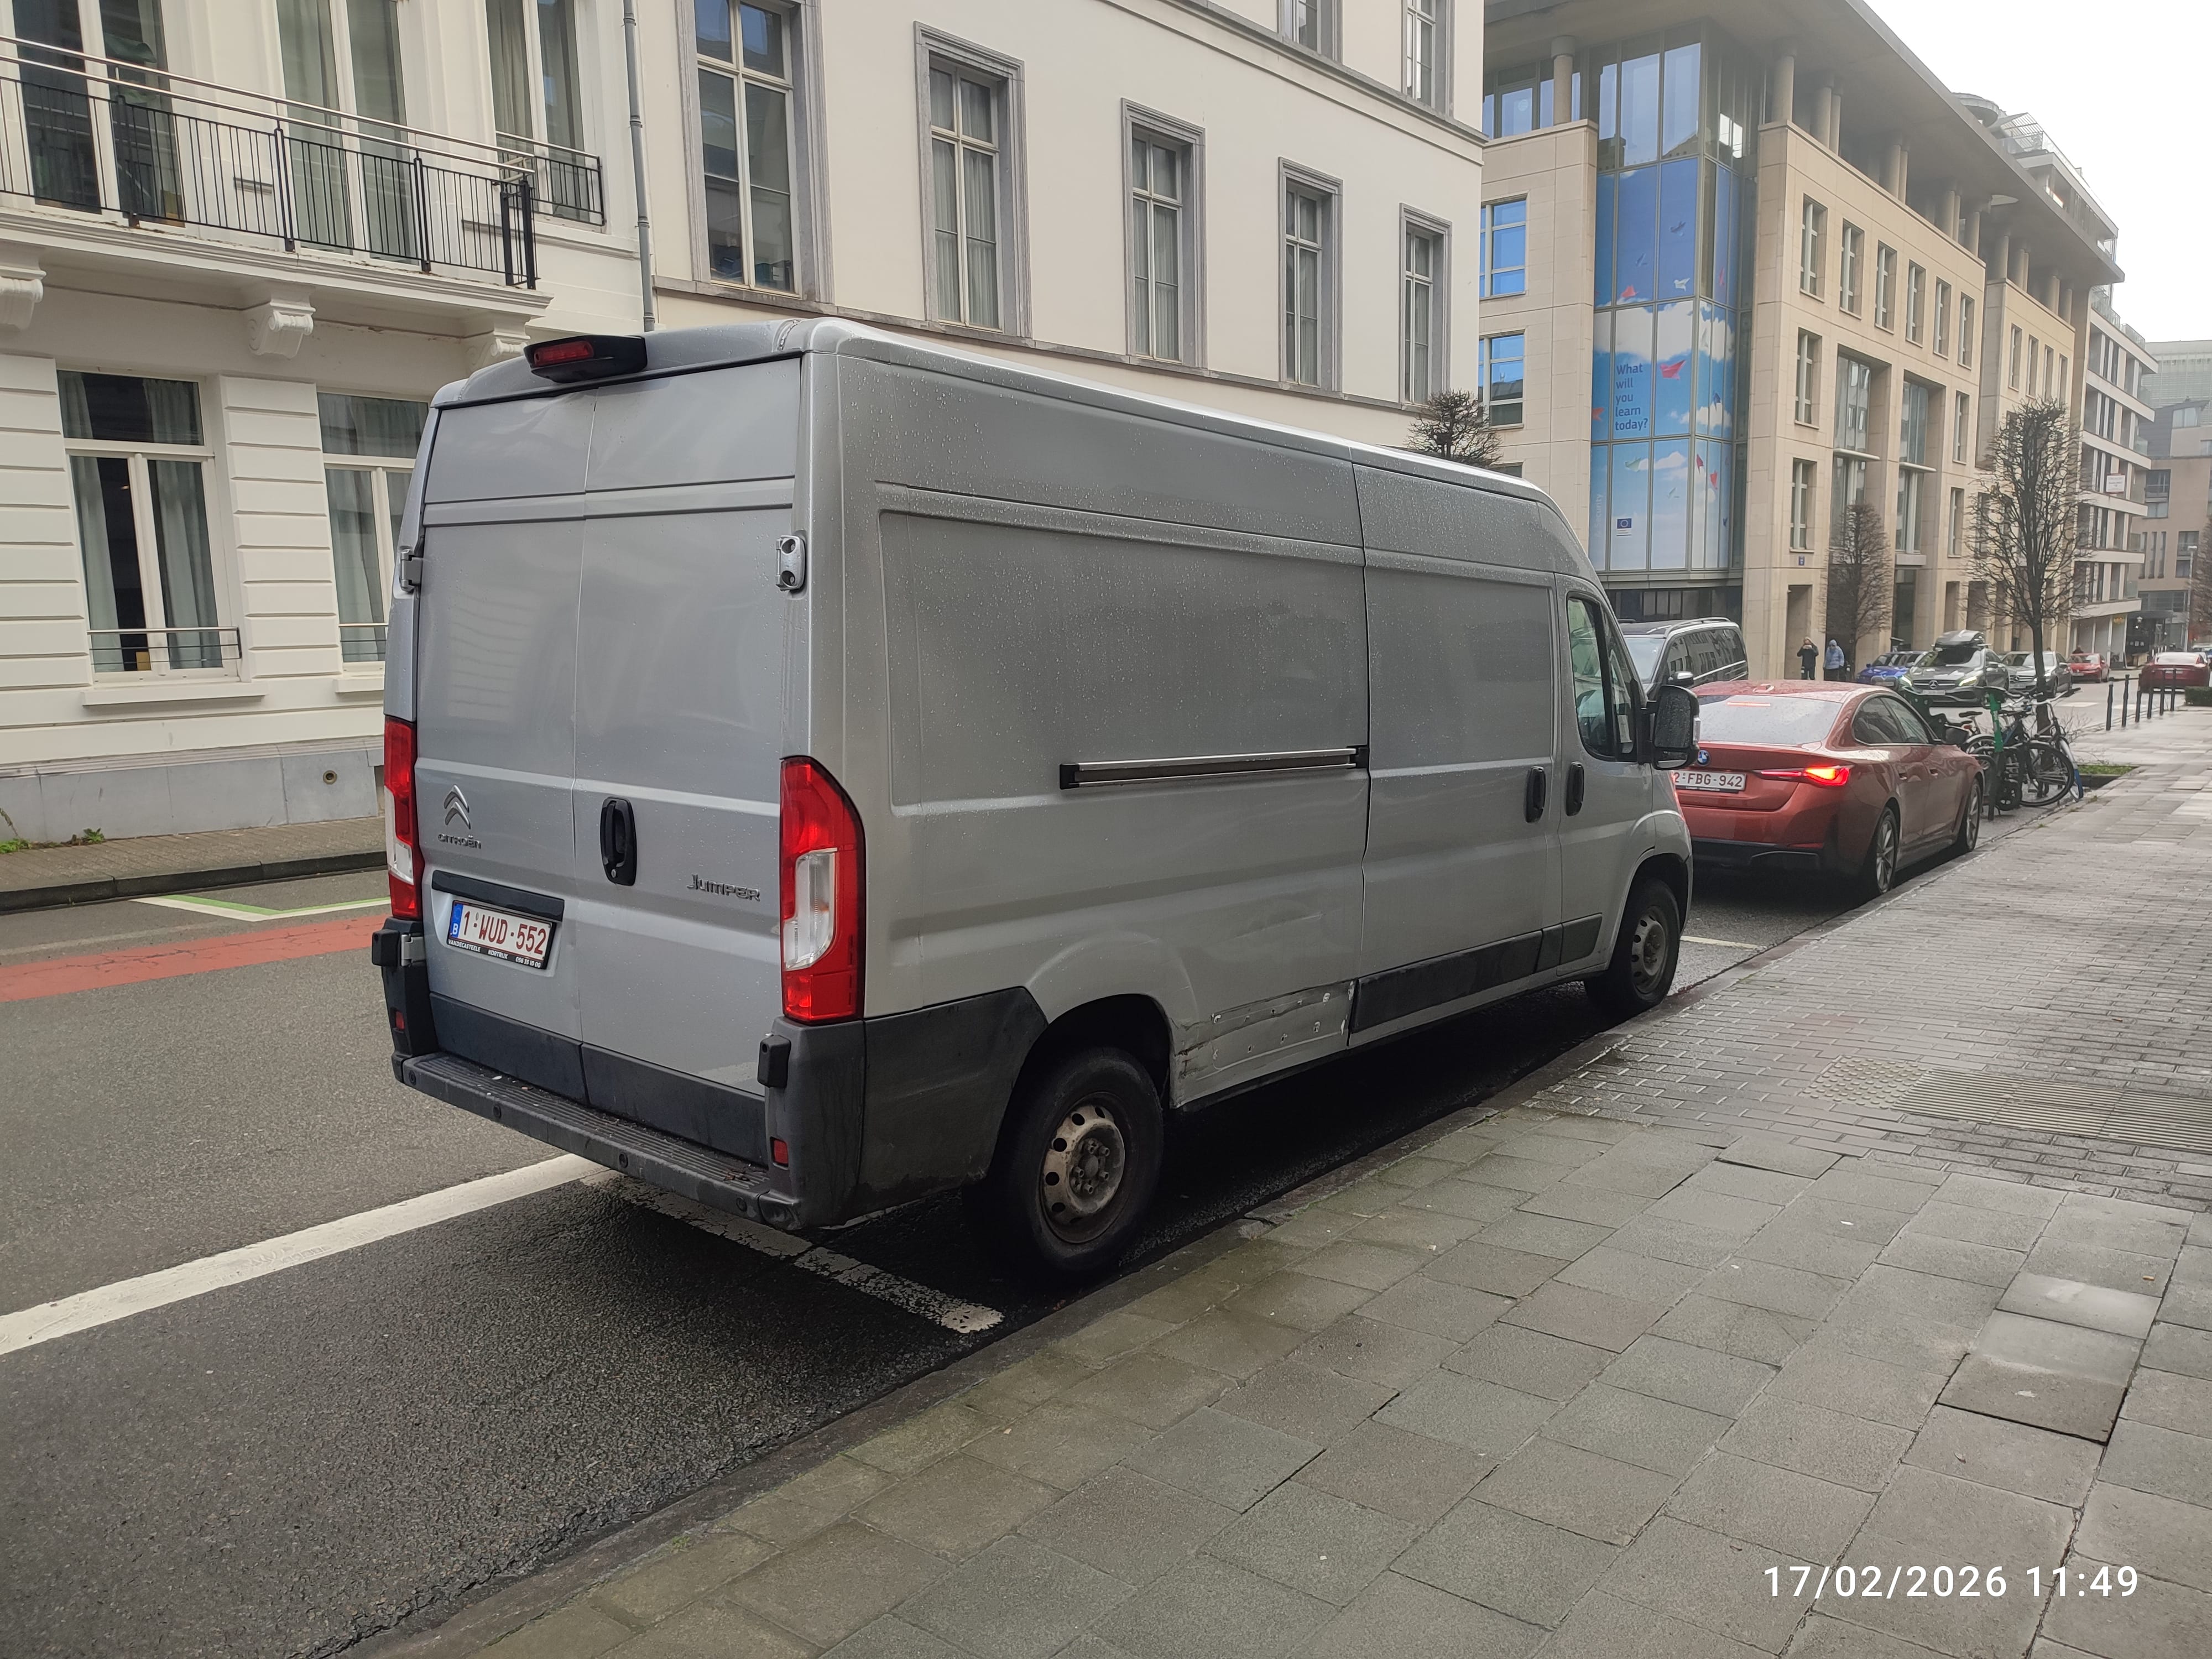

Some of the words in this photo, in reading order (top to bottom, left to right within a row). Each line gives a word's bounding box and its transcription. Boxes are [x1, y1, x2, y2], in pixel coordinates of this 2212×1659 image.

[1616, 363, 1643, 375] What
[1616, 378, 1633, 389] will
[1615, 393, 1633, 405] you
[1615, 406, 1641, 417] learn
[1615, 418, 1648, 431] today?
[1594, 494, 1603, 528] Security
[438, 833, 481, 849] CITROËN
[452, 923, 458, 935] B
[448, 939, 481, 952] VANDECASTEELE
